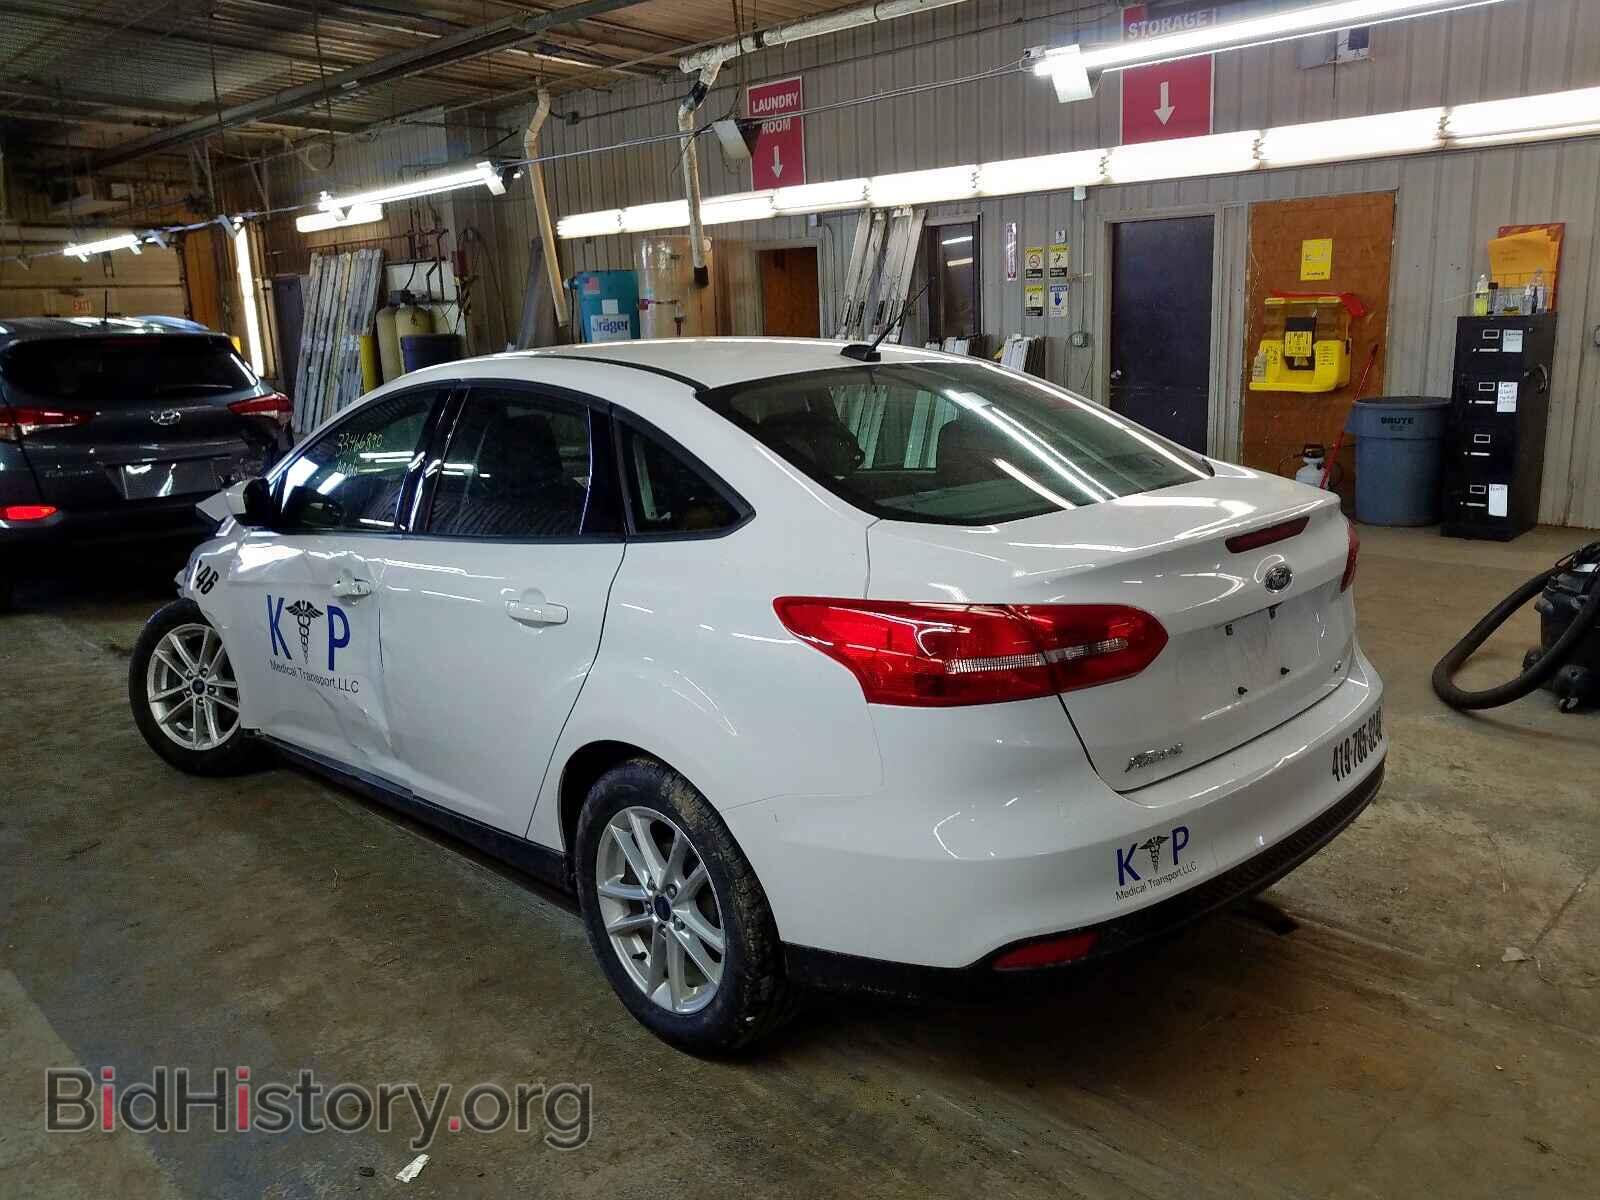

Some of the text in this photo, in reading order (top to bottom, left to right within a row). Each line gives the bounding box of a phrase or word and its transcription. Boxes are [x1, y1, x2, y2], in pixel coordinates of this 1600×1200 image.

[1128, 9, 1208, 40] STORAGE
[752, 92, 799, 113] LAUNDRY
[762, 118, 791, 134] ROOM
[73, 300, 91, 312] EXIT
[266, 595, 350, 671] K P
[269, 659, 297, 677] Medical
[1116, 826, 1190, 887] K P
[1115, 882, 1147, 901] Medical
